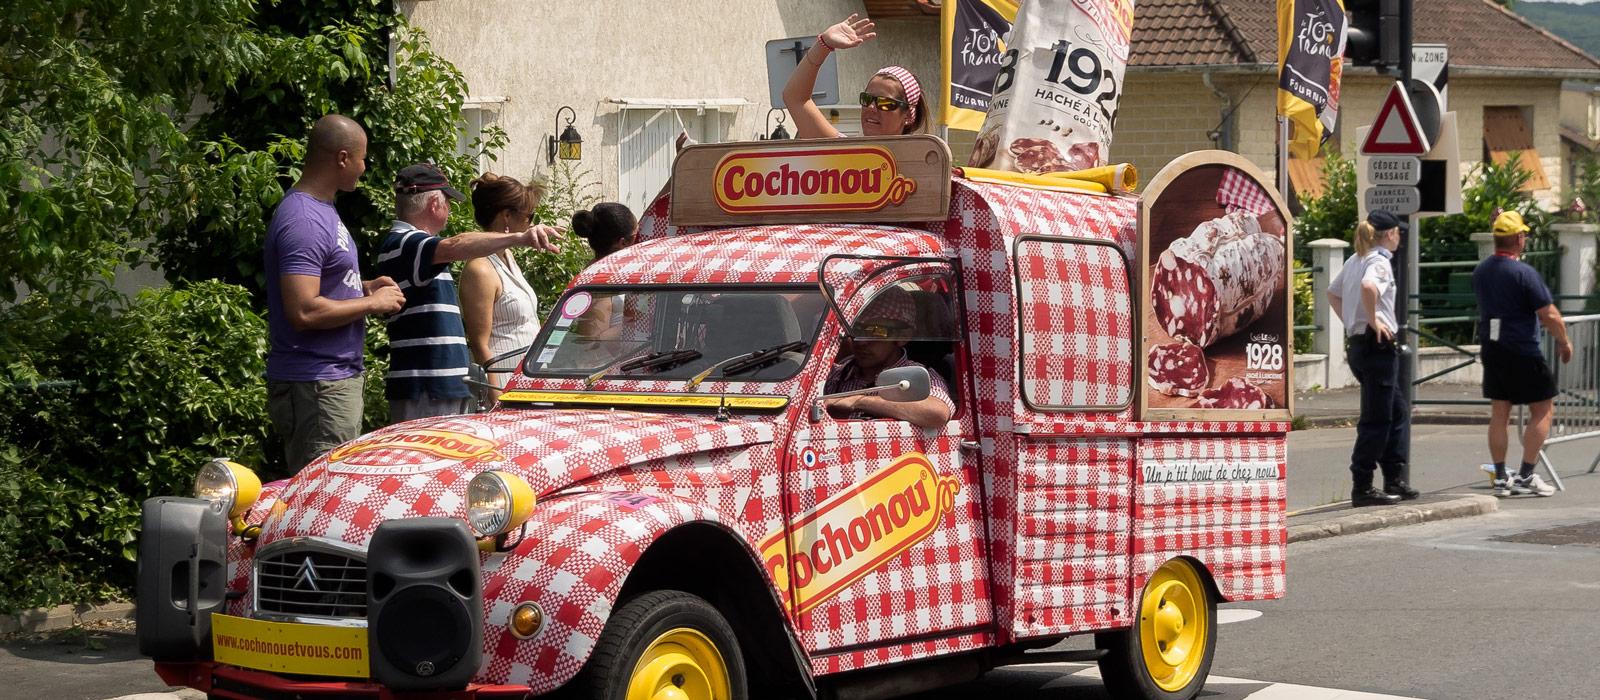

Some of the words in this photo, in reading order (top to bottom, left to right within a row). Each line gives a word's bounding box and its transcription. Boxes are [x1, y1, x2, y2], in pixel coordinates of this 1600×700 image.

[1424, 51, 1445, 63] ZONE
[1034, 88, 1082, 112] HACHÉ
[1373, 159, 1398, 170] CÉDEZ
[1402, 161, 1412, 170] LE
[1374, 171, 1409, 181] PASSAGE
[723, 163, 881, 201] Cochonou
[1245, 342, 1283, 370] 1928
[1145, 465, 1162, 484] Un
[1163, 464, 1188, 487] p'tit
[1191, 463, 1213, 481] bout
[1216, 464, 1227, 480] de
[1231, 463, 1252, 484] chez
[1255, 465, 1277, 479] nous
[766, 479, 931, 592] Cochonou
[216, 633, 363, 661] www.cochonouetvous.com
